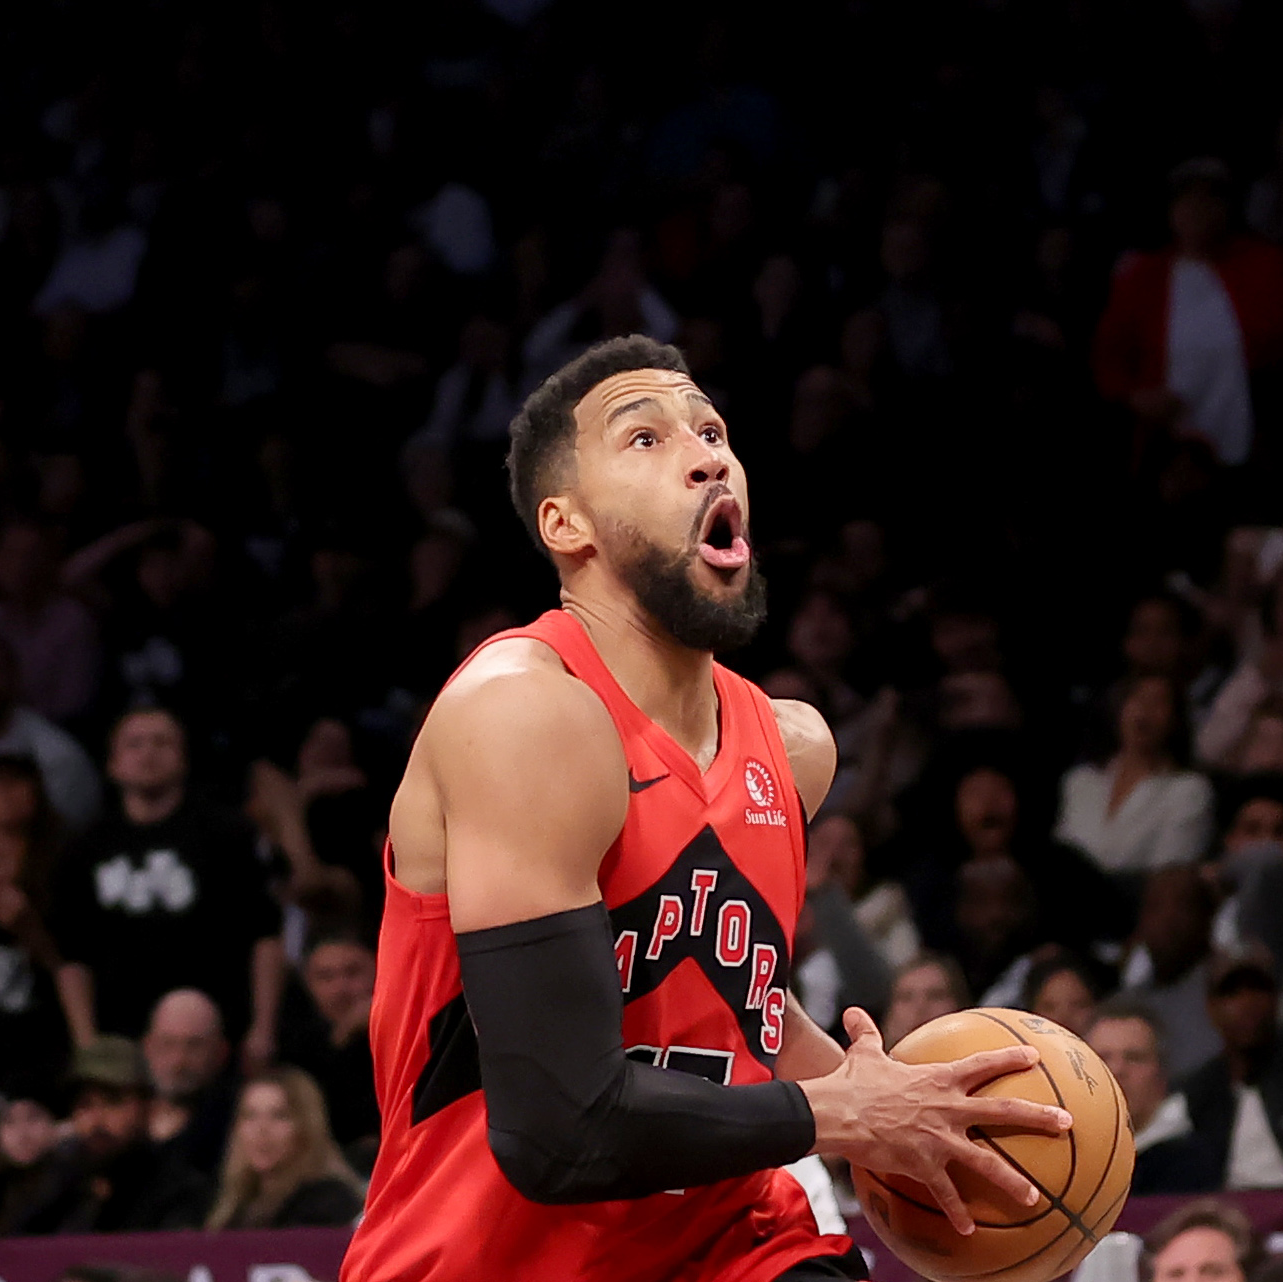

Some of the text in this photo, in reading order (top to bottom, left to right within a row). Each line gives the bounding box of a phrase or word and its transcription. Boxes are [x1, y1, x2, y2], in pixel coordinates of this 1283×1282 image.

[745, 808, 787, 827] Sun Life
[614, 869, 785, 1055] APTORS
